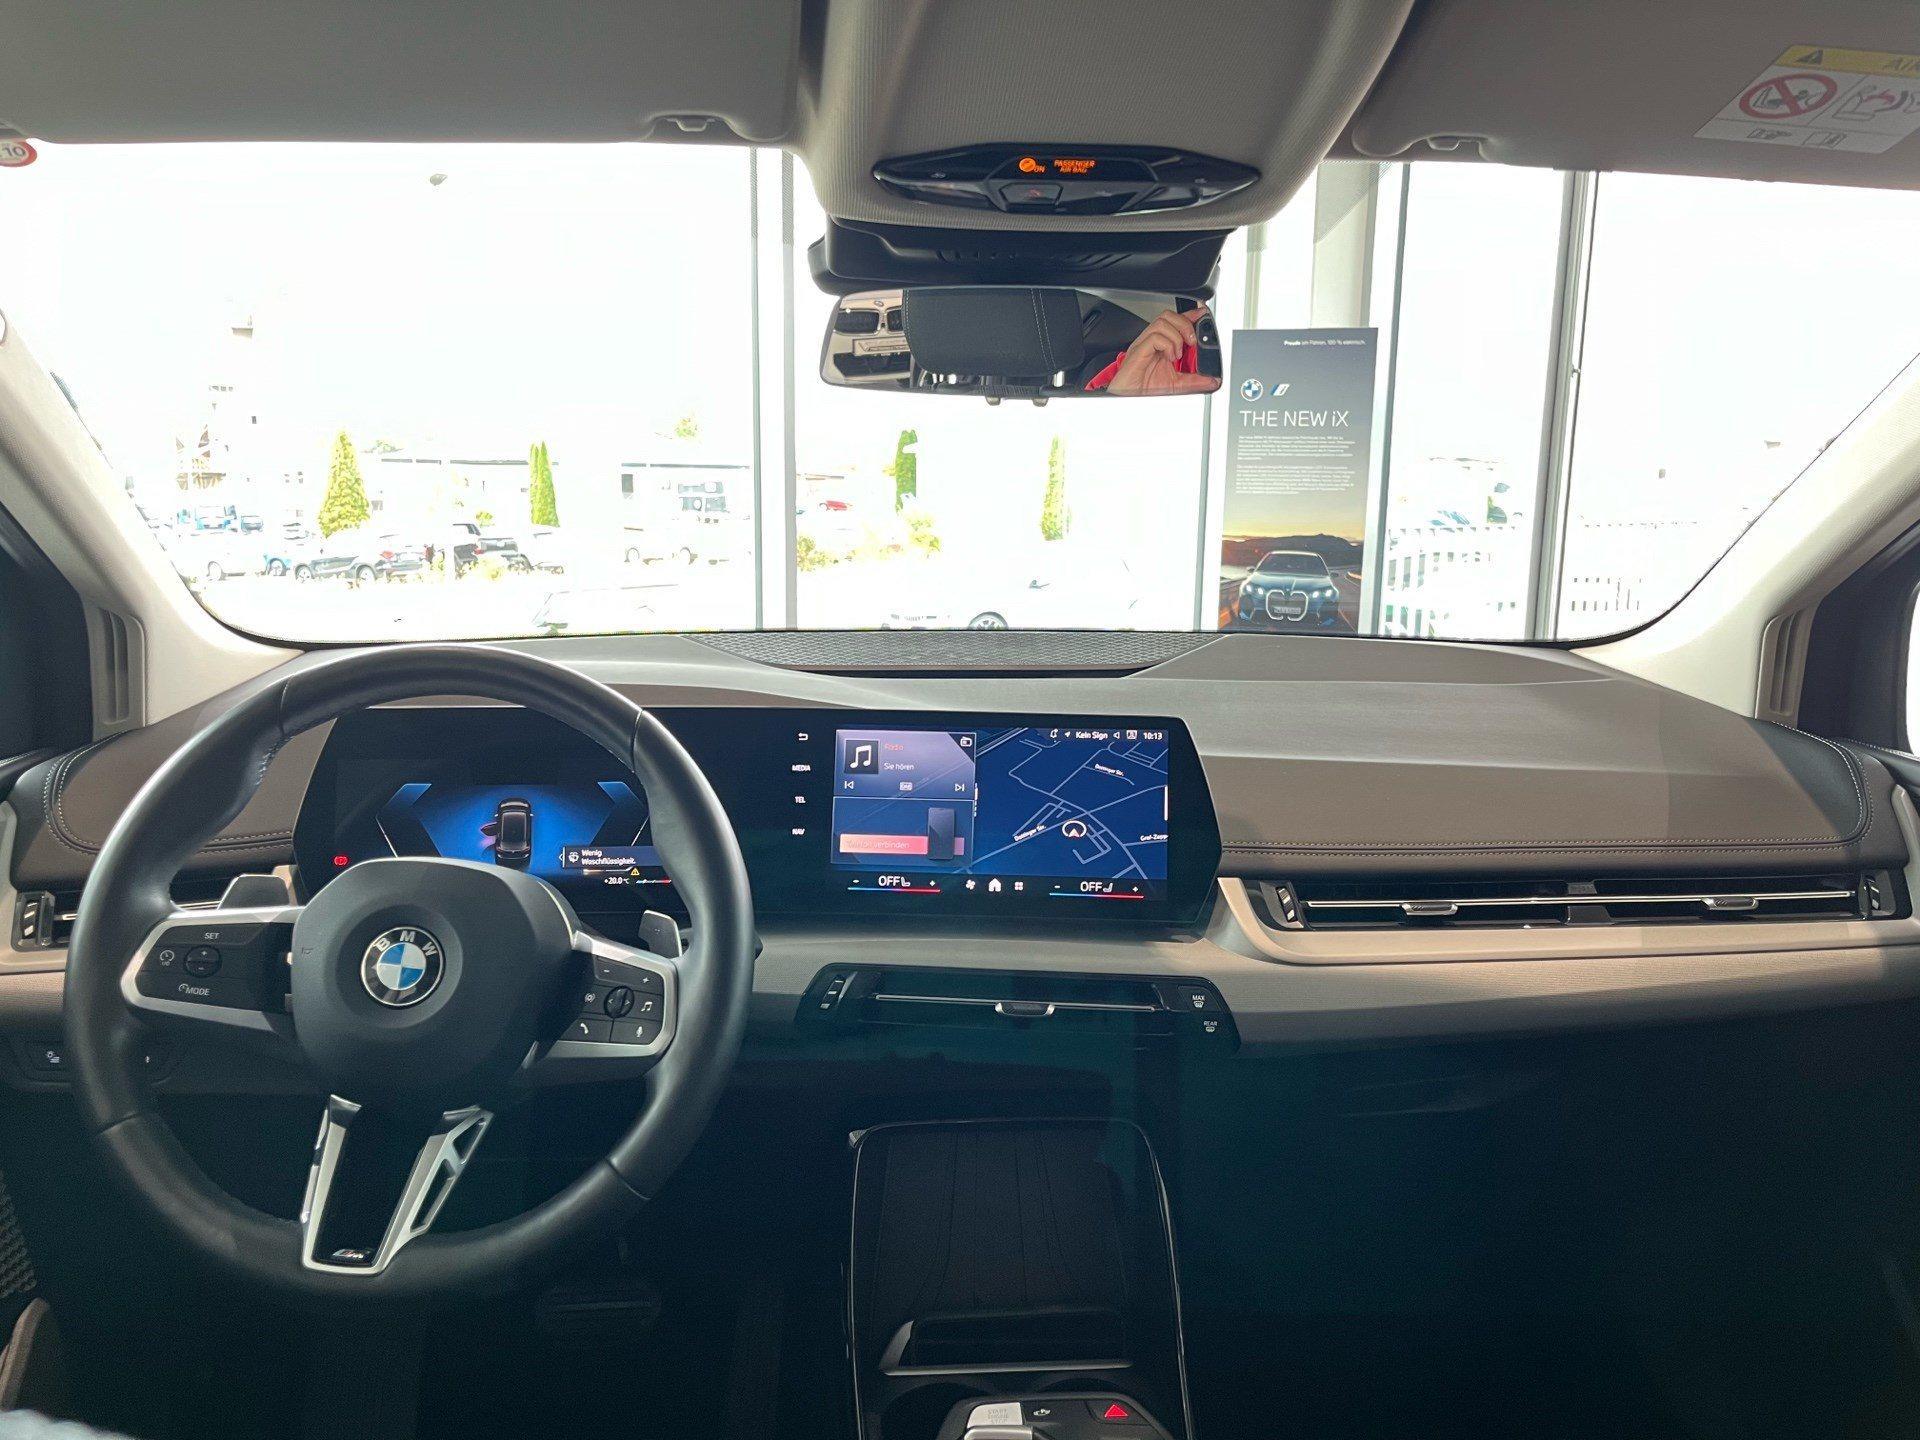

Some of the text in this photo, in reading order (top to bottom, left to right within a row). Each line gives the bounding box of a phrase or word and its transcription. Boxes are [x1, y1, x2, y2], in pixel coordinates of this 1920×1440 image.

[1239, 410, 1349, 427] THE NEW iX
[1075, 731, 1108, 741] Kein Sign
[1143, 732, 1163, 740] 10:13
[791, 764, 811, 772] MEDIA
[884, 762, 915, 771] Sie hören
[794, 796, 806, 804] TEL
[581, 849, 603, 858] Wenig
[878, 876, 900, 887] OFF
[1080, 881, 1102, 892] OFF
[204, 932, 220, 940] SET
[376, 931, 437, 956] BMW
[185, 987, 210, 996] MODE
